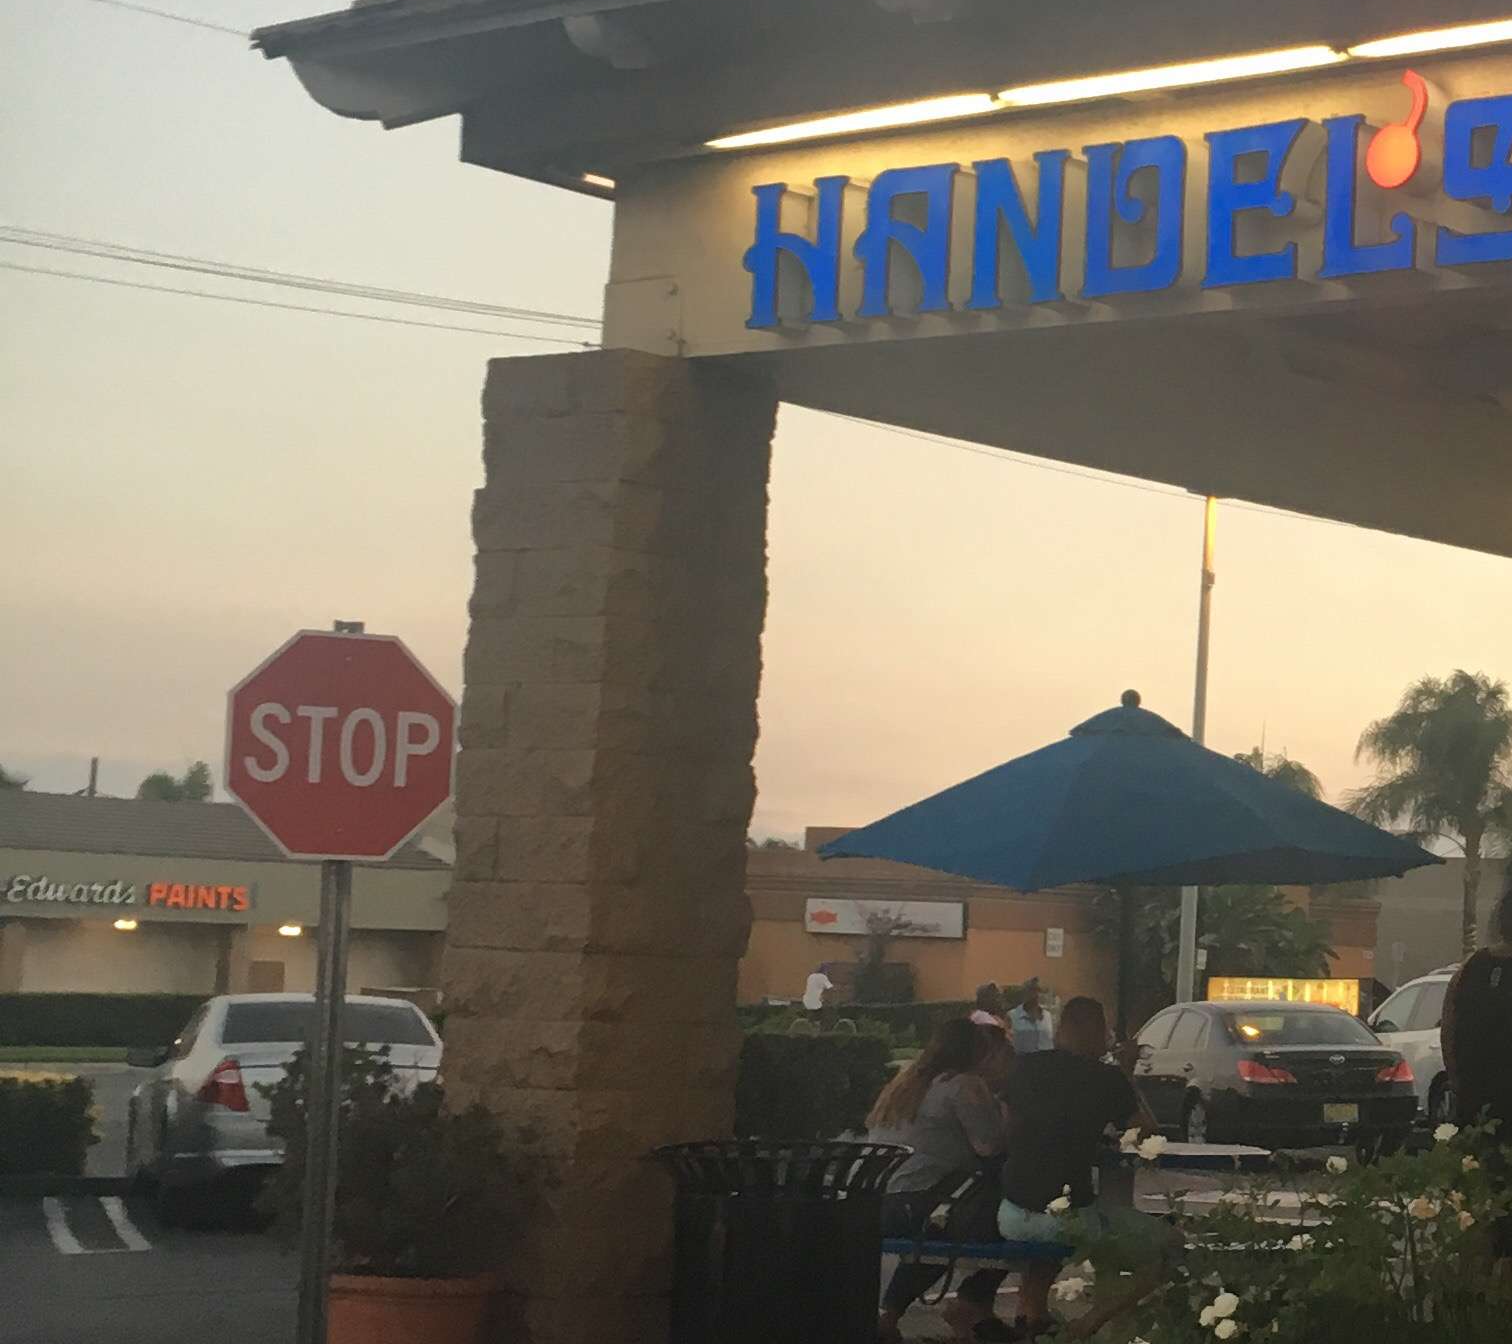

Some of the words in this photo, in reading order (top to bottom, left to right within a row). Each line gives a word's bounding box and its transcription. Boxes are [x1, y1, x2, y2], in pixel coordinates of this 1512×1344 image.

[243, 701, 441, 788] STOP
[6, 875, 137, 906] Edwards
[149, 881, 251, 912] PAINTS
